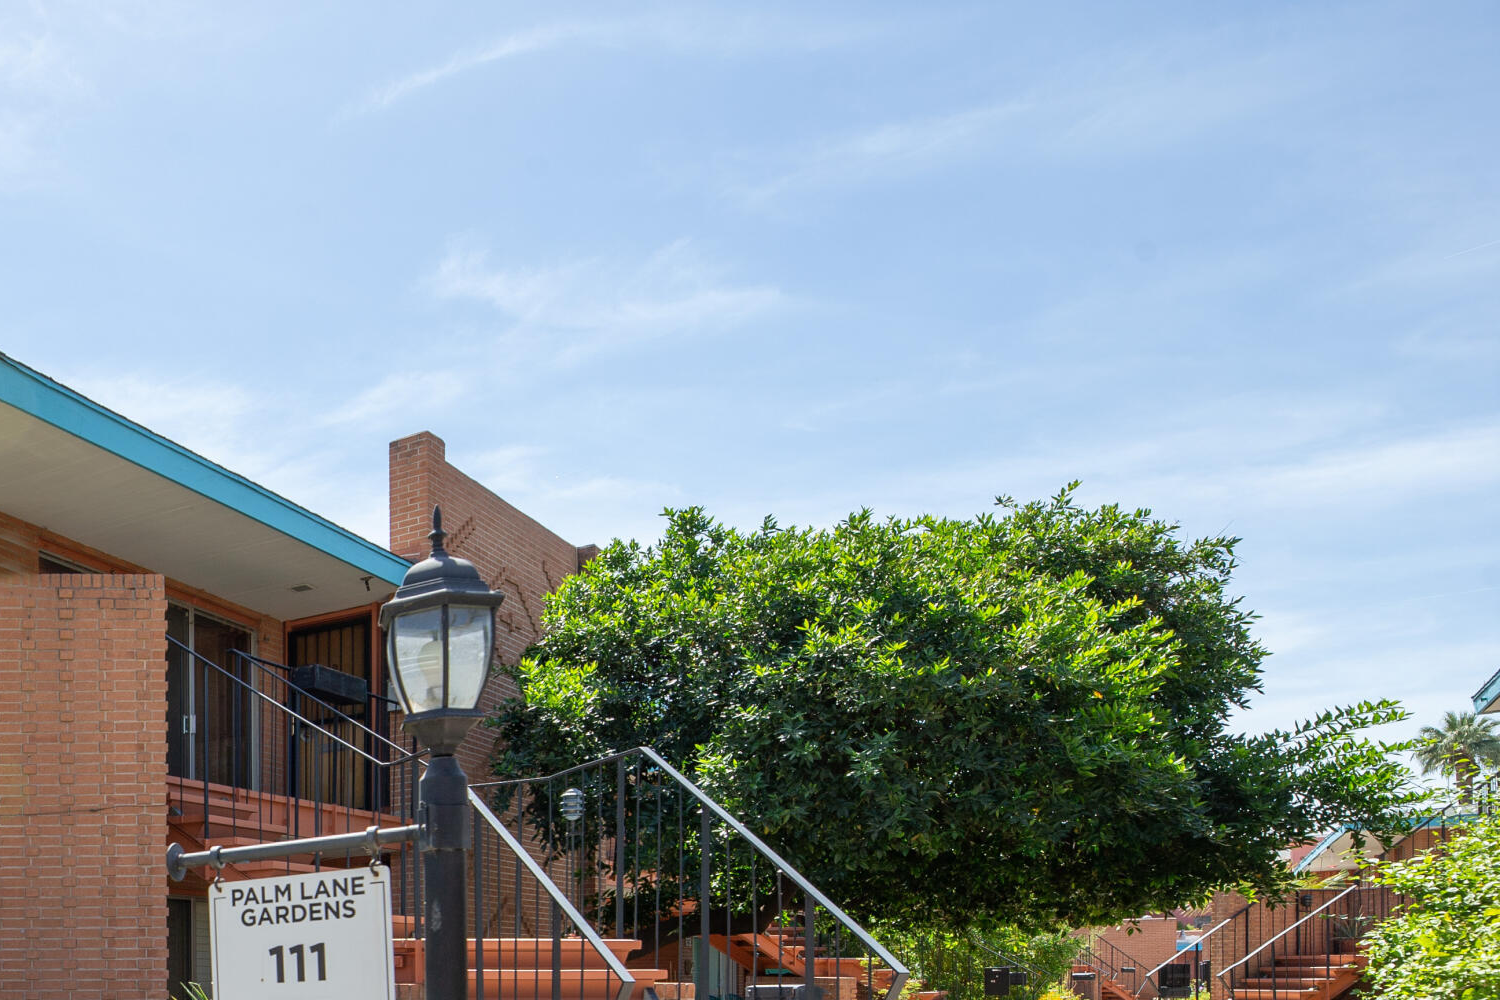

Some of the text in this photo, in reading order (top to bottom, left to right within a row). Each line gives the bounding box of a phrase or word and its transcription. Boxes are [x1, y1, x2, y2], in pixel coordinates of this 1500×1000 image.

[231, 876, 365, 907] PALM LANE
[241, 900, 356, 927] GARDENS
[268, 942, 327, 984] 111
